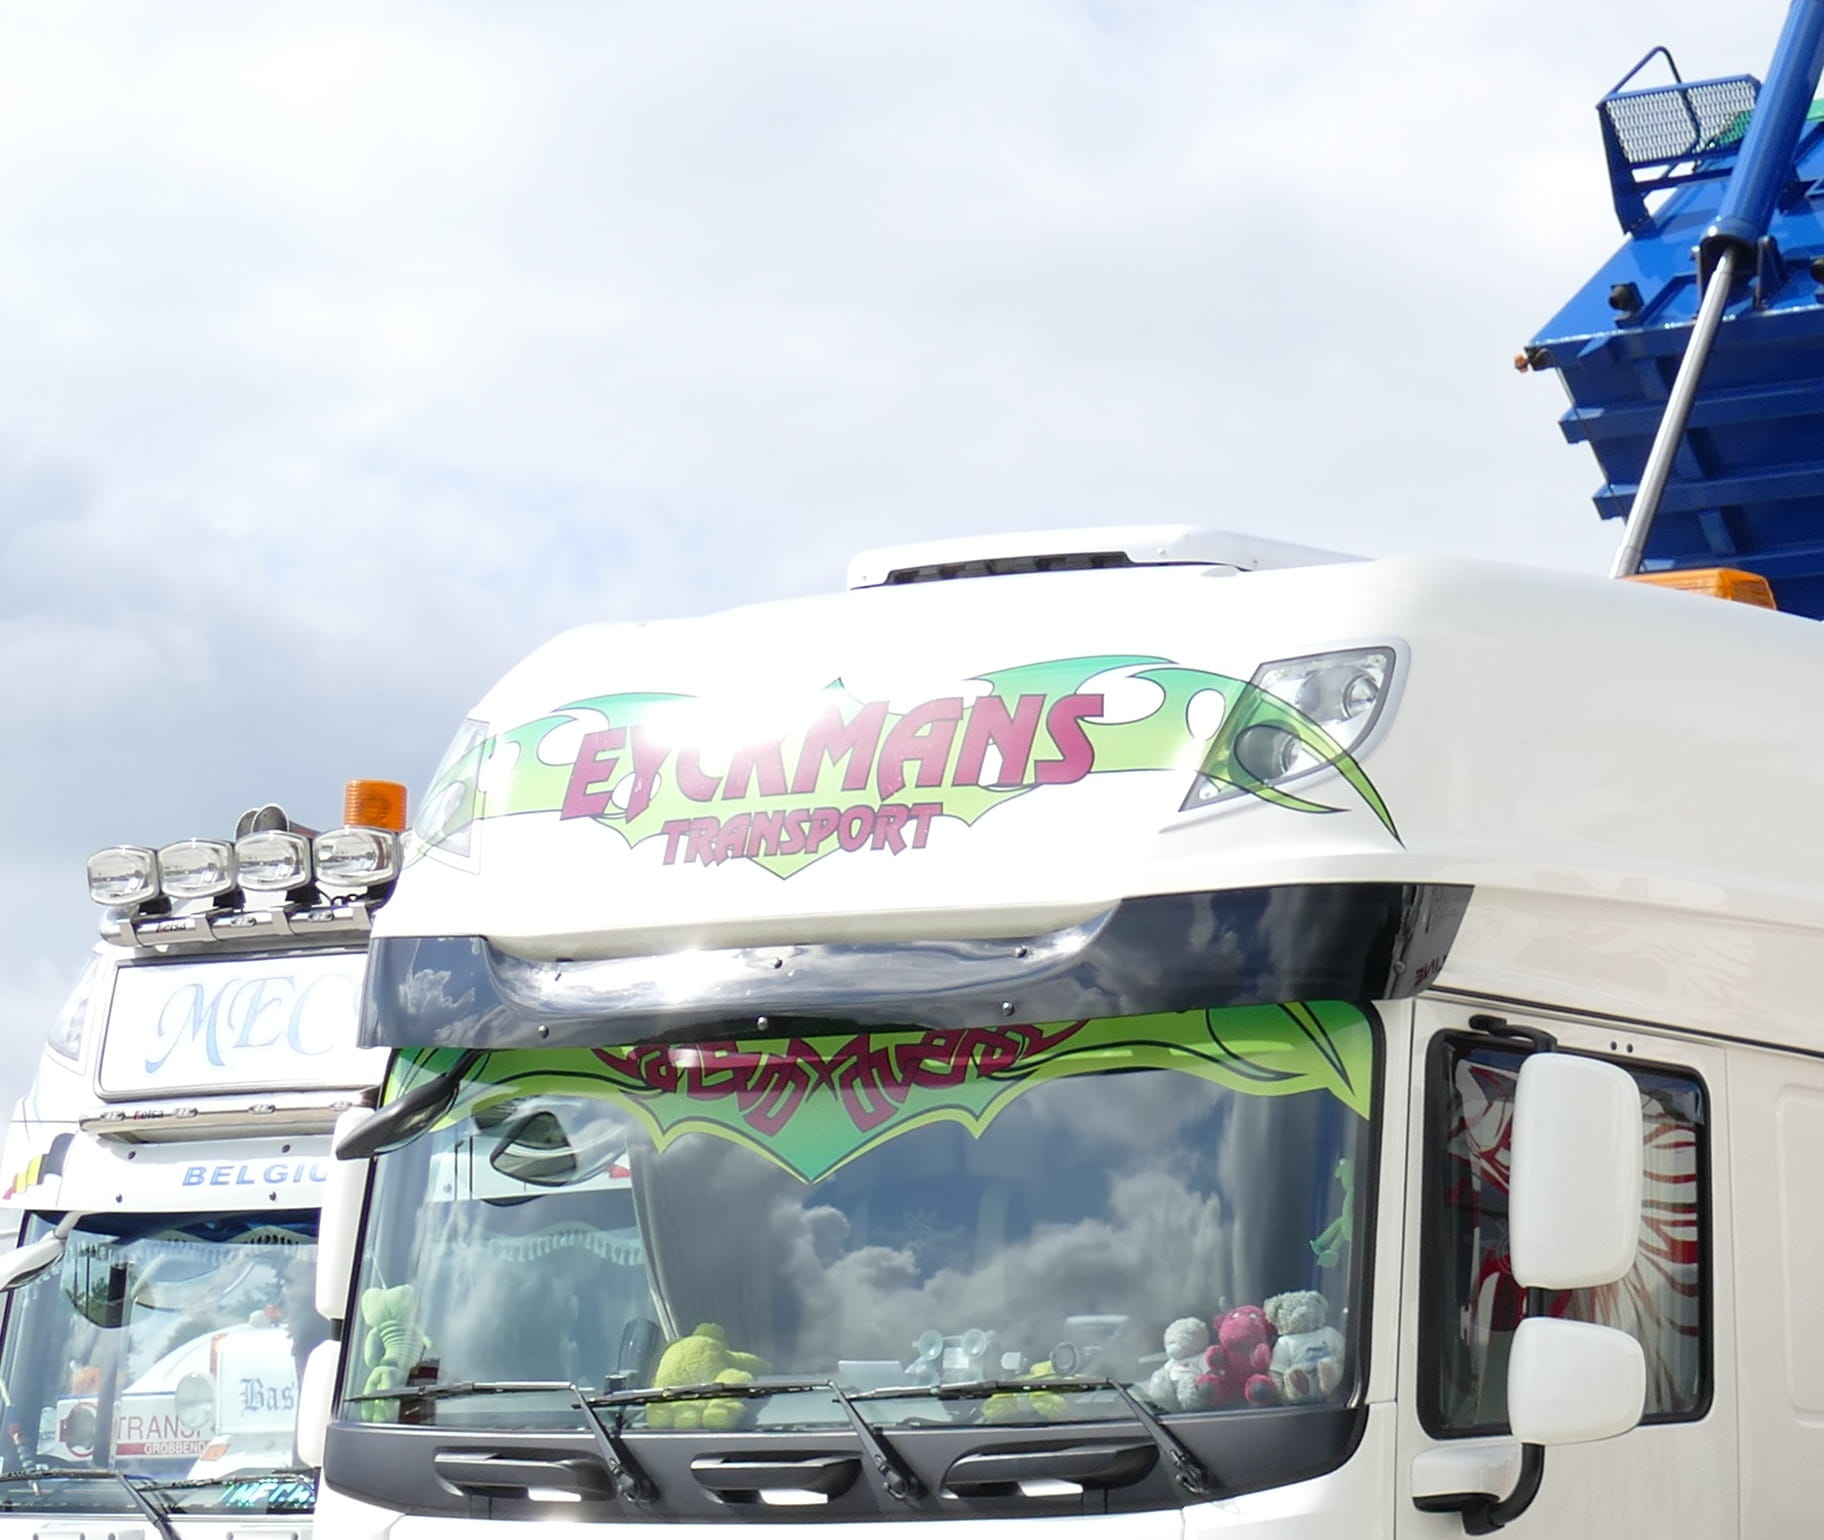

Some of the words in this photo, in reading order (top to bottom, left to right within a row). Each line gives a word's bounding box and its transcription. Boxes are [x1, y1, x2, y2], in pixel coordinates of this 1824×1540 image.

[661, 802, 943, 866] TRANSPORT
[145, 973, 353, 1073] MEC
[182, 1163, 328, 1186] BELGIU
[240, 1378, 298, 1416] Bas
[116, 1415, 202, 1440] TRAN
